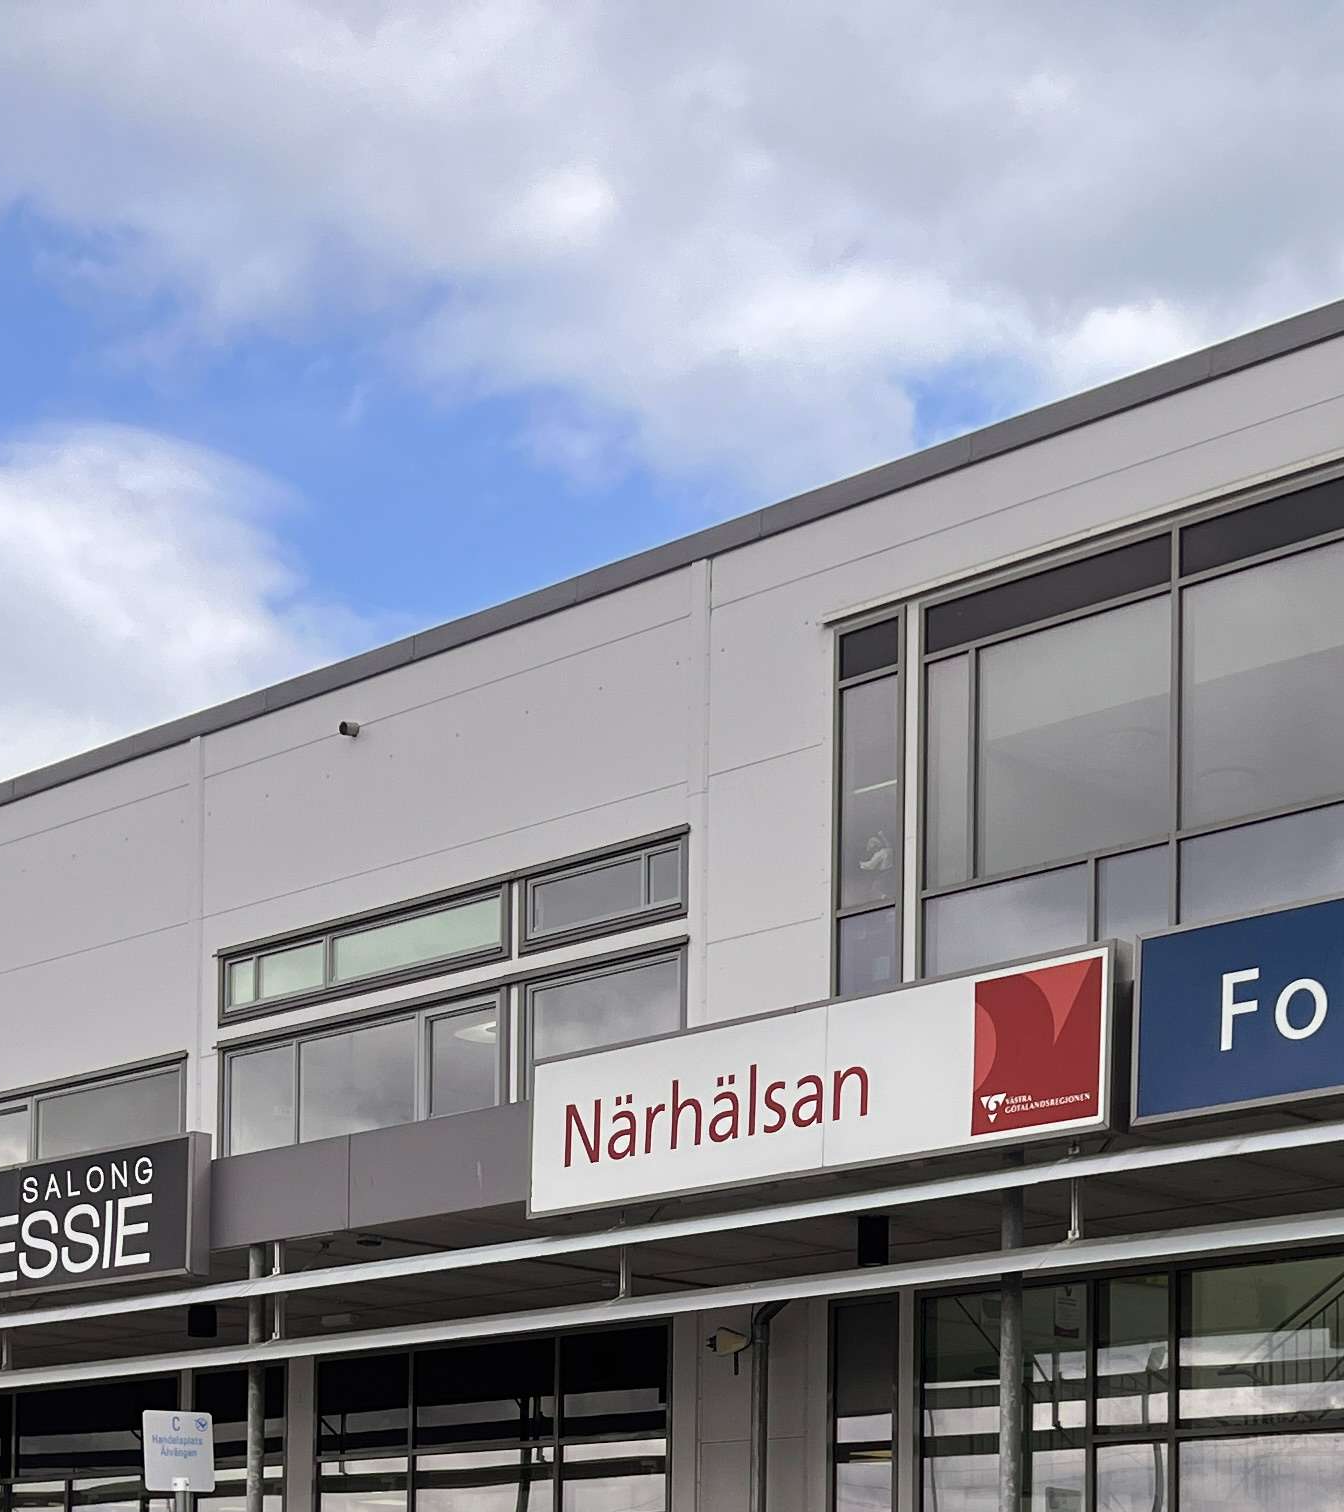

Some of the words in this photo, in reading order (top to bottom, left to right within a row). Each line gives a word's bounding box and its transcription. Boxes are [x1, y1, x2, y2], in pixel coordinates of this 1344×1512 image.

[563, 1063, 869, 1168] Närhälsan
[1004, 1091, 1091, 1114] GÖTALANDSREGIONEN
[22, 1156, 153, 1204] SALONG
[172, 1416, 181, 1432] C
